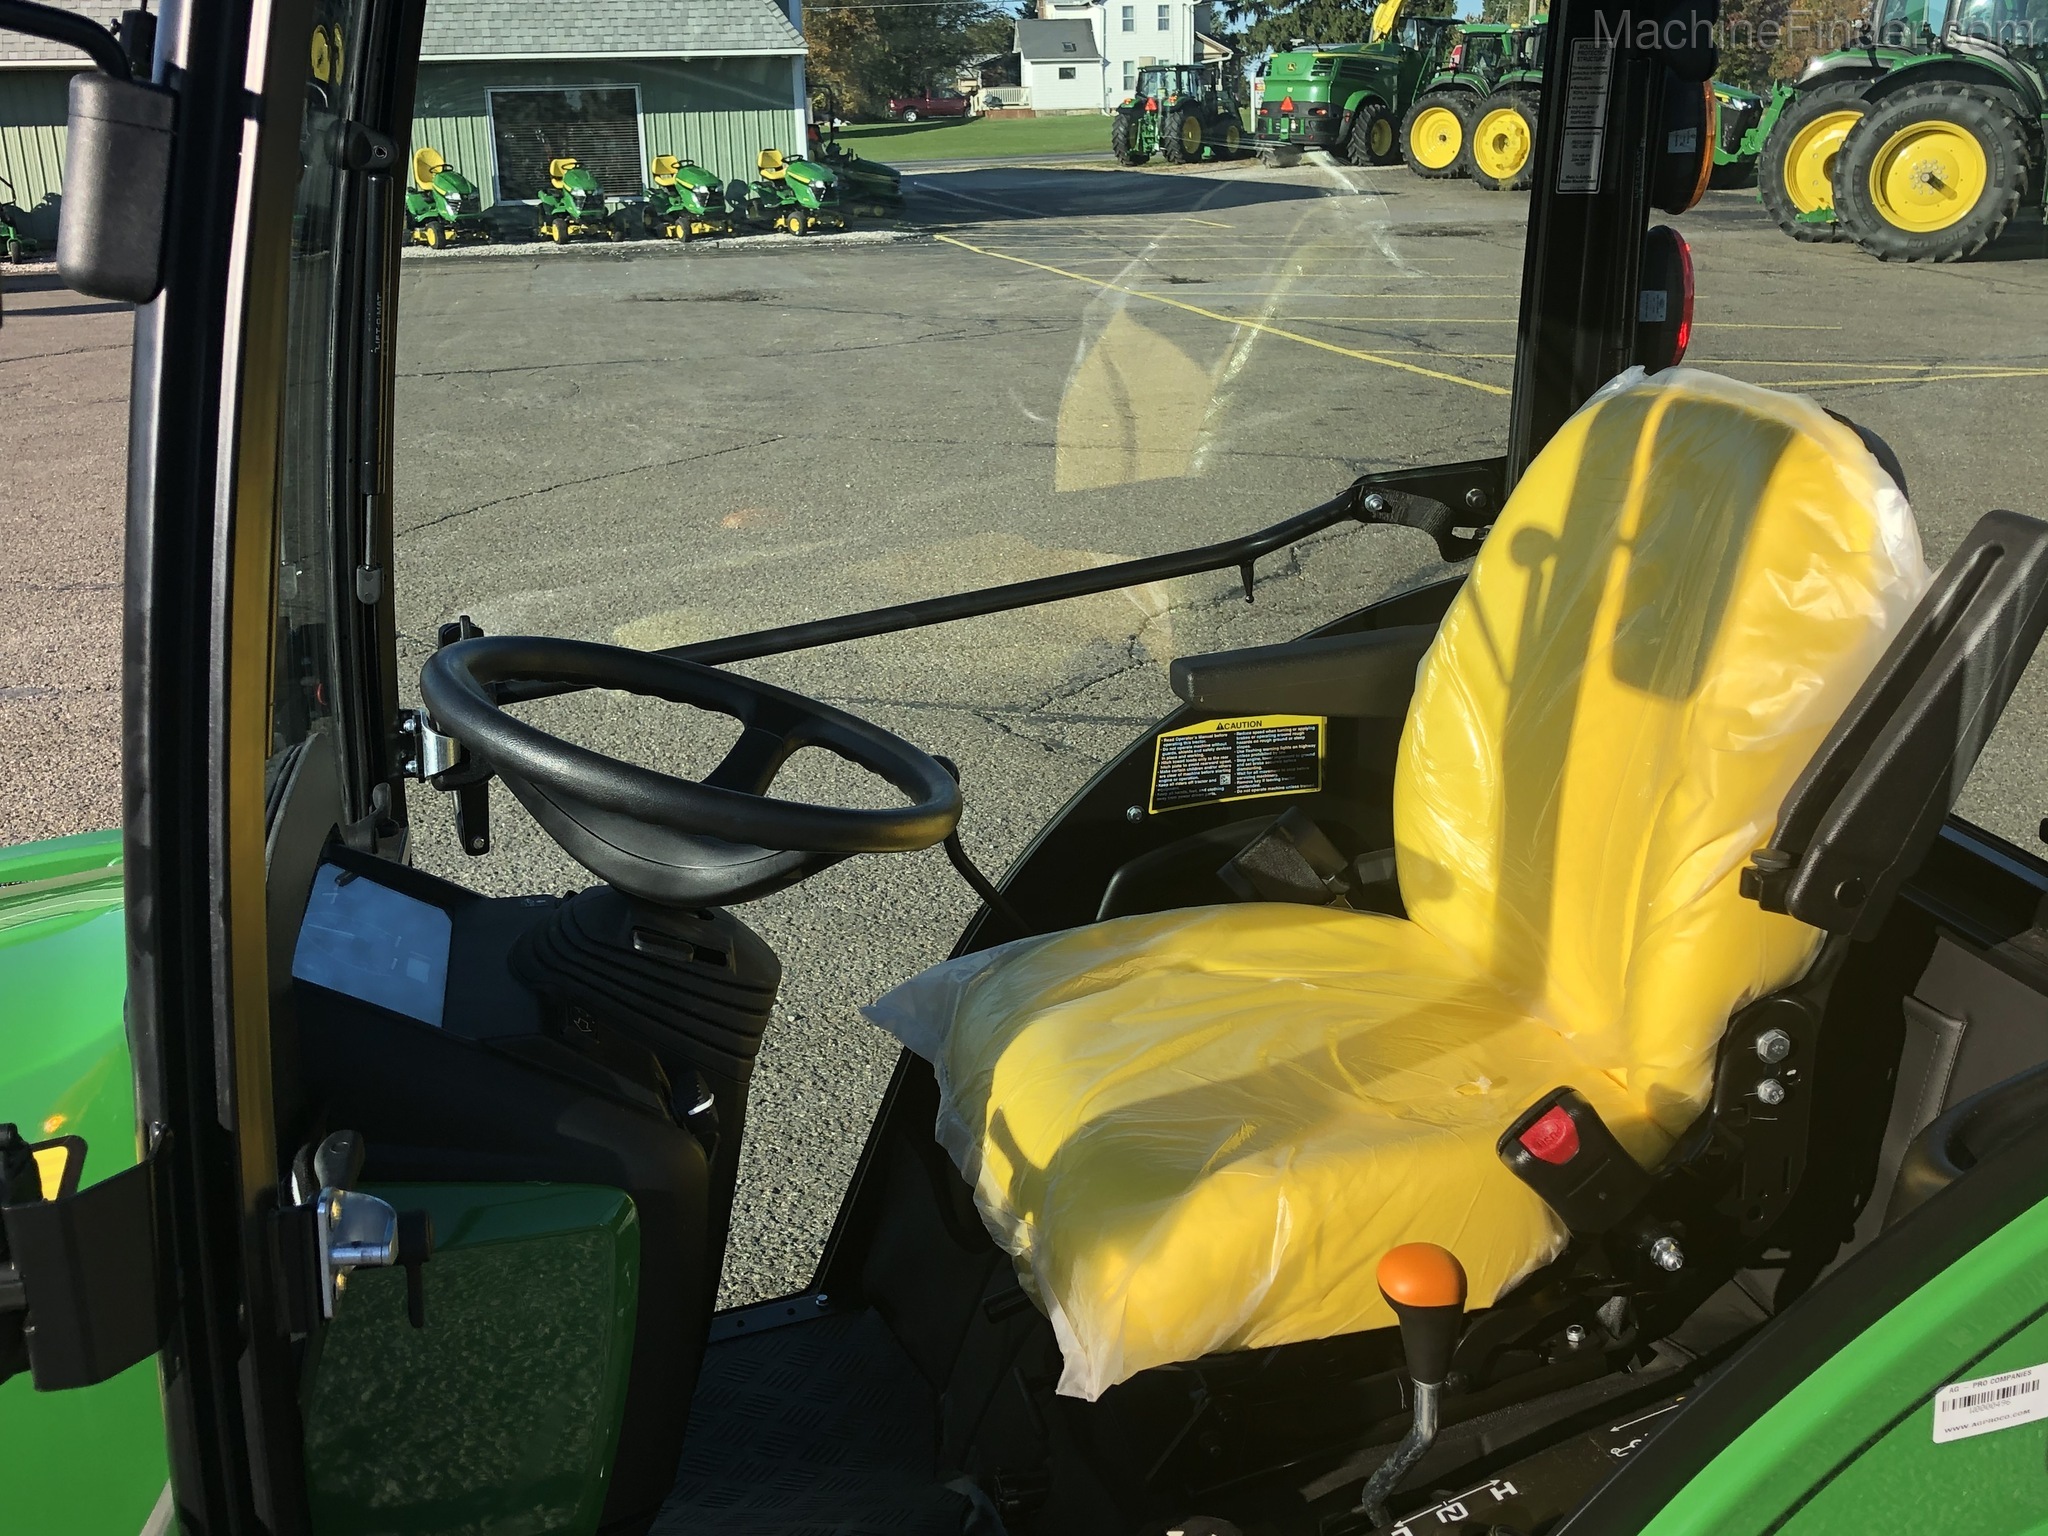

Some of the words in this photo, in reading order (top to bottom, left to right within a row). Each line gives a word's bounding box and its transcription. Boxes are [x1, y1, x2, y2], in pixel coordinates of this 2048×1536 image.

[1224, 720, 1262, 729] CAUTION
[1949, 1386, 1960, 1394] AG
[1972, 1380, 1988, 1389] PRO
[1990, 1370, 2032, 1385] COMPANIES
